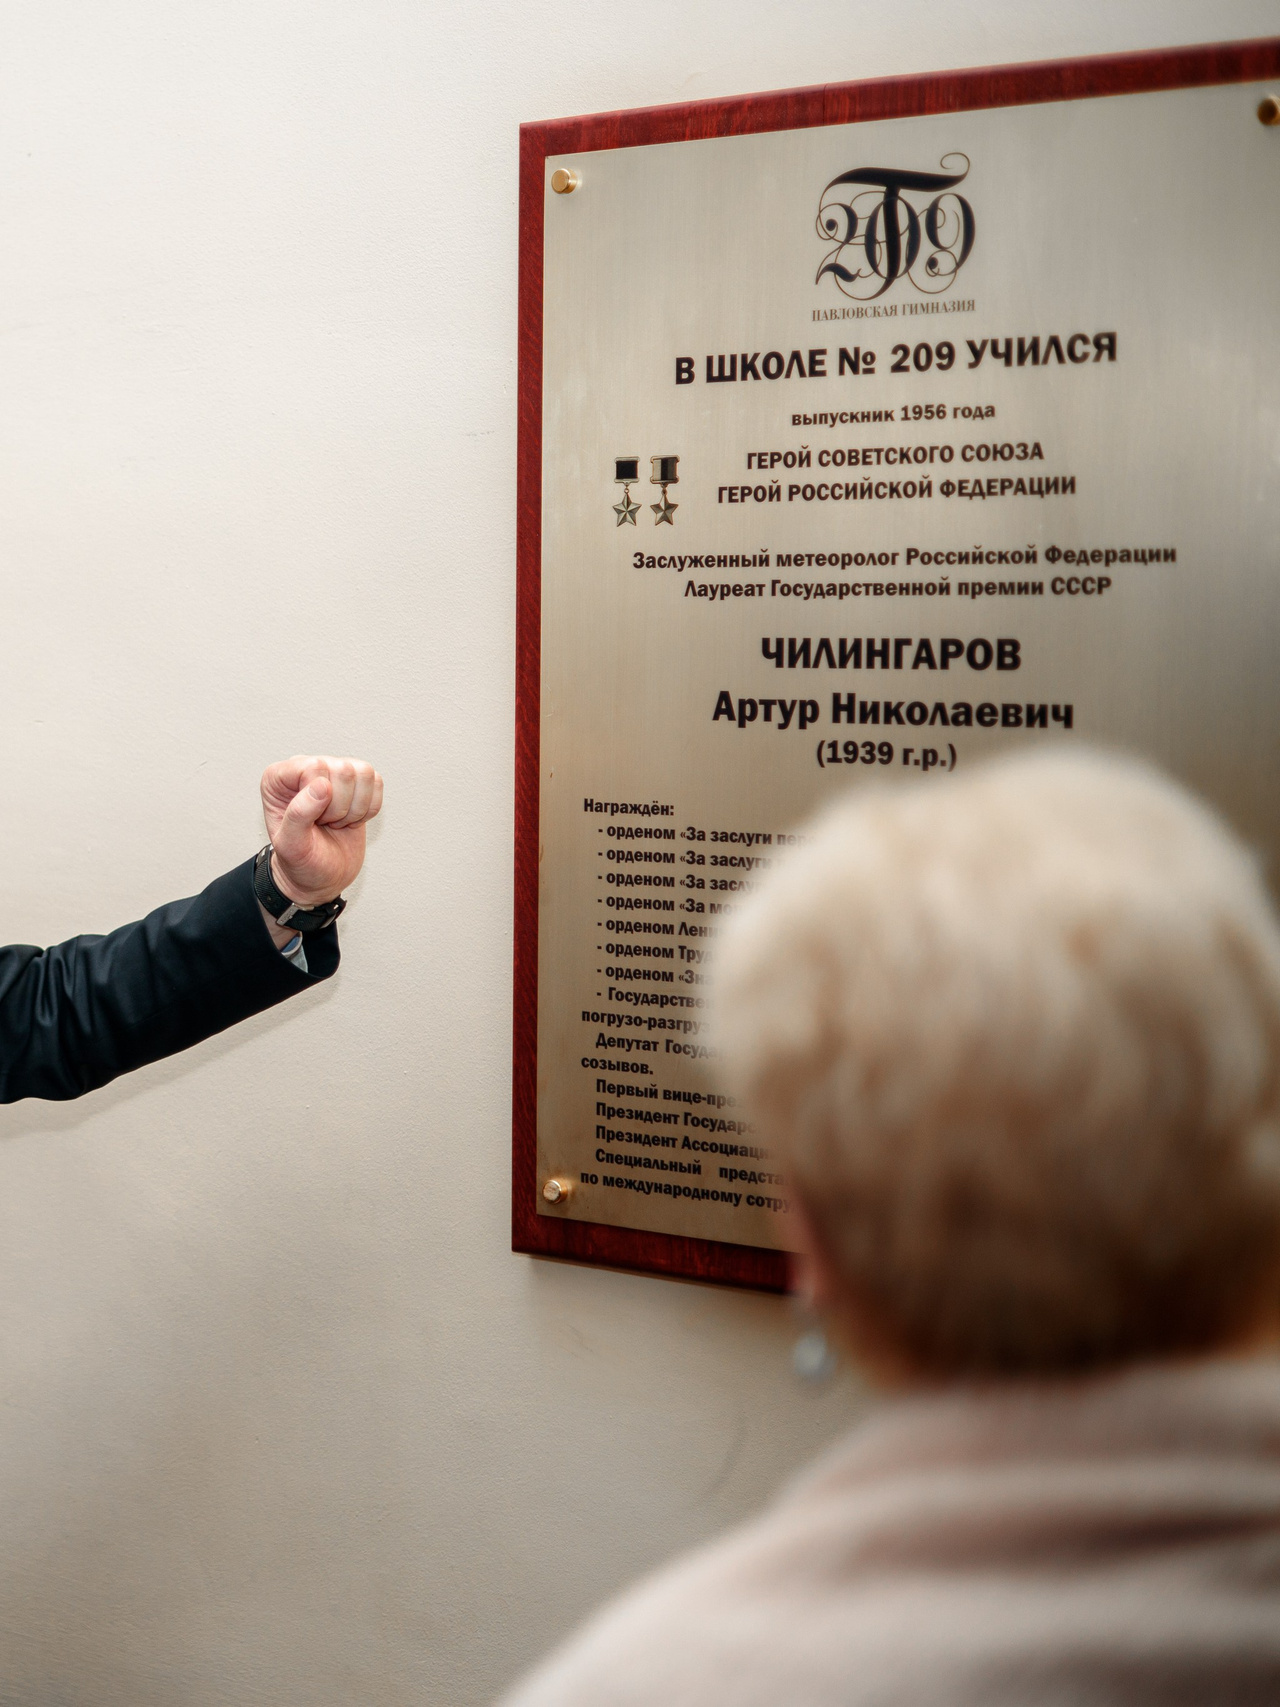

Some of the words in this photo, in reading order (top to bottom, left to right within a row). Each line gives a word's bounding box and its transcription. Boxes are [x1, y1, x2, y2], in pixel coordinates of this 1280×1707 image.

[812, 304, 898, 322] ПАВЛОВСКАЯ
[902, 299, 976, 316] ГИМНАЗИЯ
[675, 356, 695, 385] В
[705, 349, 827, 383] ШКОЛЕ
[838, 346, 877, 376] №
[890, 341, 956, 373] 209
[966, 331, 1118, 370] УЧИЛСЯ
[791, 407, 895, 429] выпускник
[900, 404, 946, 422] 1956
[952, 405, 995, 421] года
[747, 445, 812, 470] ГЕРОЙ
[818, 446, 954, 468] СОВЕТСКОГО
[961, 441, 1044, 462] СОЮЗА
[718, 479, 782, 504] ГЕРОЙ
[788, 475, 932, 502] РОССИЙСКОЙ
[939, 476, 1076, 500] ФЕДЕРАЦИИ
[632, 548, 770, 572] Заслуженный
[776, 549, 899, 571] метеоролог
[906, 544, 1038, 567] Российской
[1044, 546, 1177, 566] Федерации
[684, 580, 766, 600] Лауреат
[771, 576, 951, 600] Государственной
[957, 579, 1044, 600] премии
[1050, 576, 1112, 596] СССР
[761, 637, 1022, 671] ЧИЛИНГАРОВ
[712, 691, 820, 730] Артур
[832, 693, 1074, 729] Николаевич
[816, 740, 894, 768] (1939
[902, 743, 957, 772] г.р.)
[583, 798, 675, 817] Награждён:
[607, 825, 675, 840] орденом
[680, 827, 706, 841] «За
[710, 830, 772, 847] заслуги
[607, 849, 675, 864] орденом
[680, 850, 705, 865] «За
[606, 872, 675, 888] орденом
[679, 874, 705, 889] «За
[606, 896, 675, 911] орденом
[679, 898, 705, 913] «За
[606, 919, 674, 935] орденом
[678, 922, 721, 938] Лени
[605, 943, 674, 958] орденом
[678, 945, 717, 963] Труд
[605, 966, 674, 982] орденом
[678, 969, 716, 985] «Зна
[581, 1010, 711, 1036] погрузо-разгруз
[595, 1032, 659, 1052] Депутат
[665, 1039, 720, 1061] Госуда
[581, 1057, 654, 1075] созывов.
[596, 1078, 658, 1099] Первый
[596, 1102, 680, 1125] Президент
[683, 1112, 757, 1135] Государс
[596, 1125, 678, 1148] Президент
[681, 1136, 773, 1160] Ассоциаци
[595, 1148, 701, 1175] Специальный
[719, 1166, 788, 1186] предста
[580, 1172, 599, 1185] по
[602, 1175, 742, 1207] международному
[746, 1194, 791, 1214] сотру
